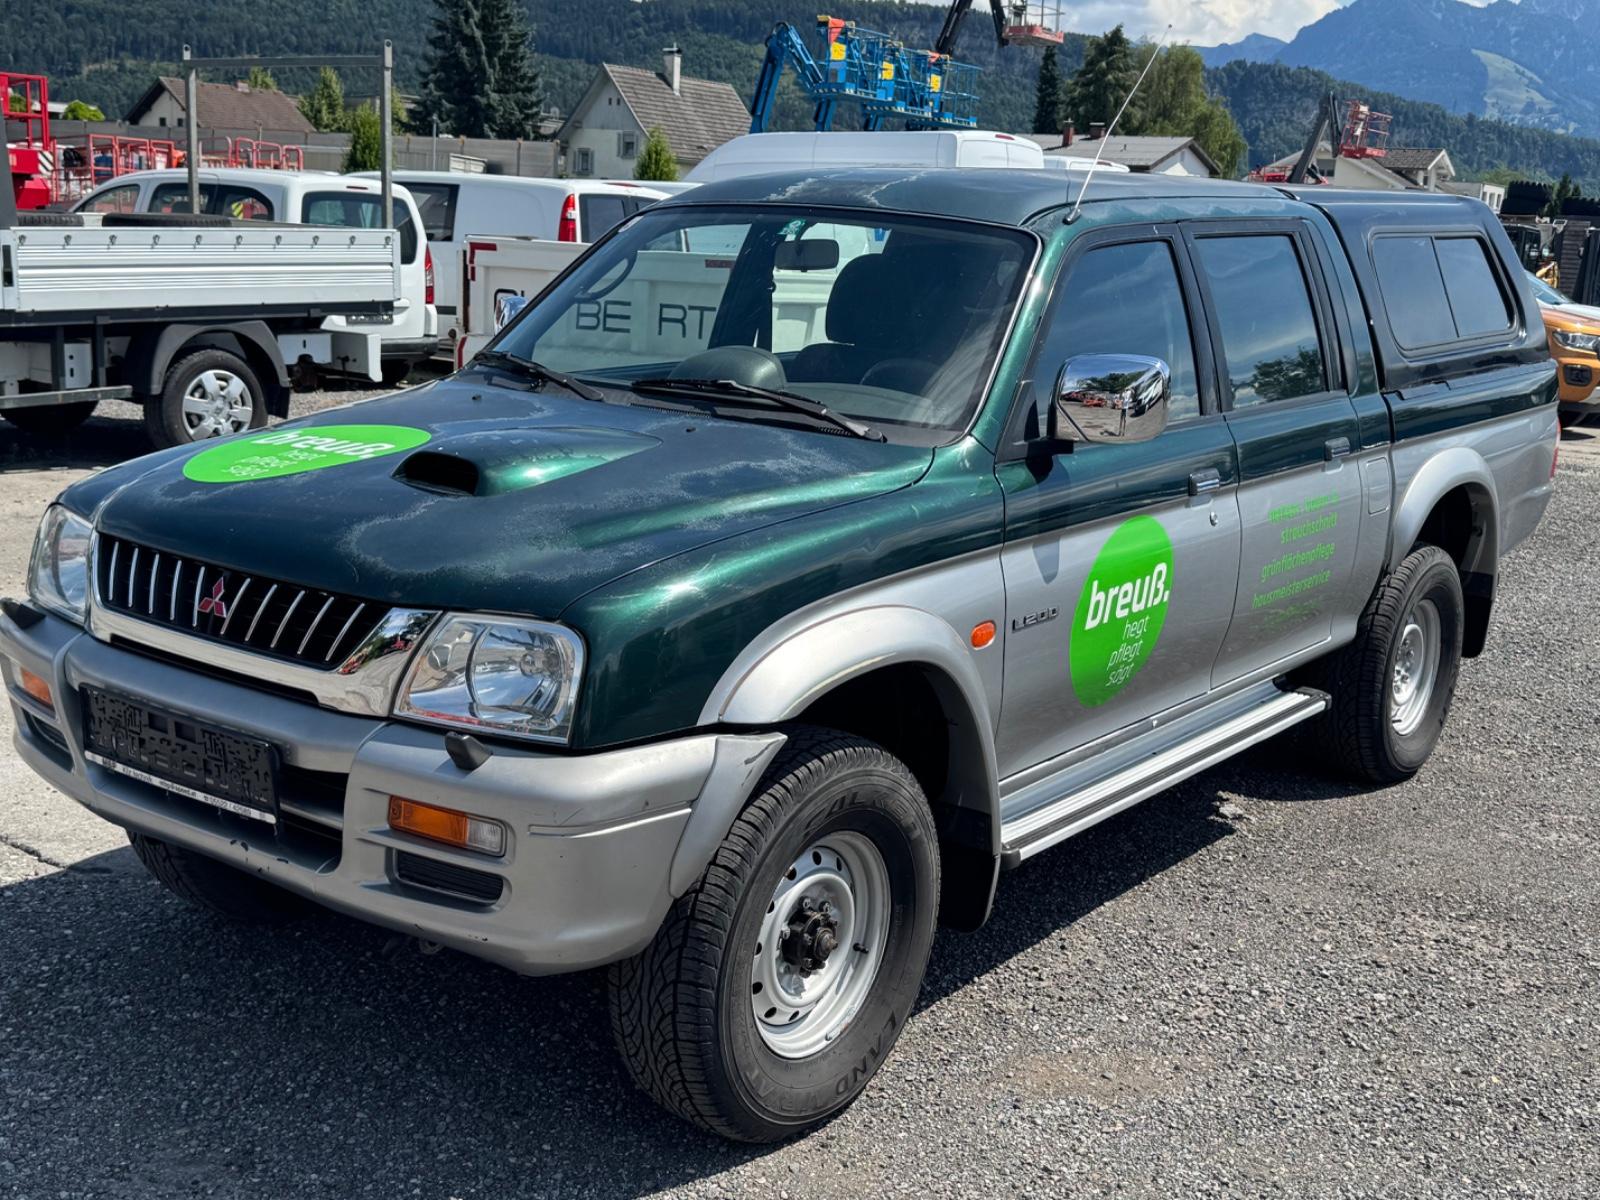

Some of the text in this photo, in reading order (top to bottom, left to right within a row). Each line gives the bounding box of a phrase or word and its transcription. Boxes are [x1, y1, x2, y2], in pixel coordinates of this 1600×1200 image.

[1084, 562, 1170, 630] breuß.
[1011, 605, 1060, 633] L200
[1122, 615, 1150, 641] hegt
[1107, 640, 1144, 671] pflegt
